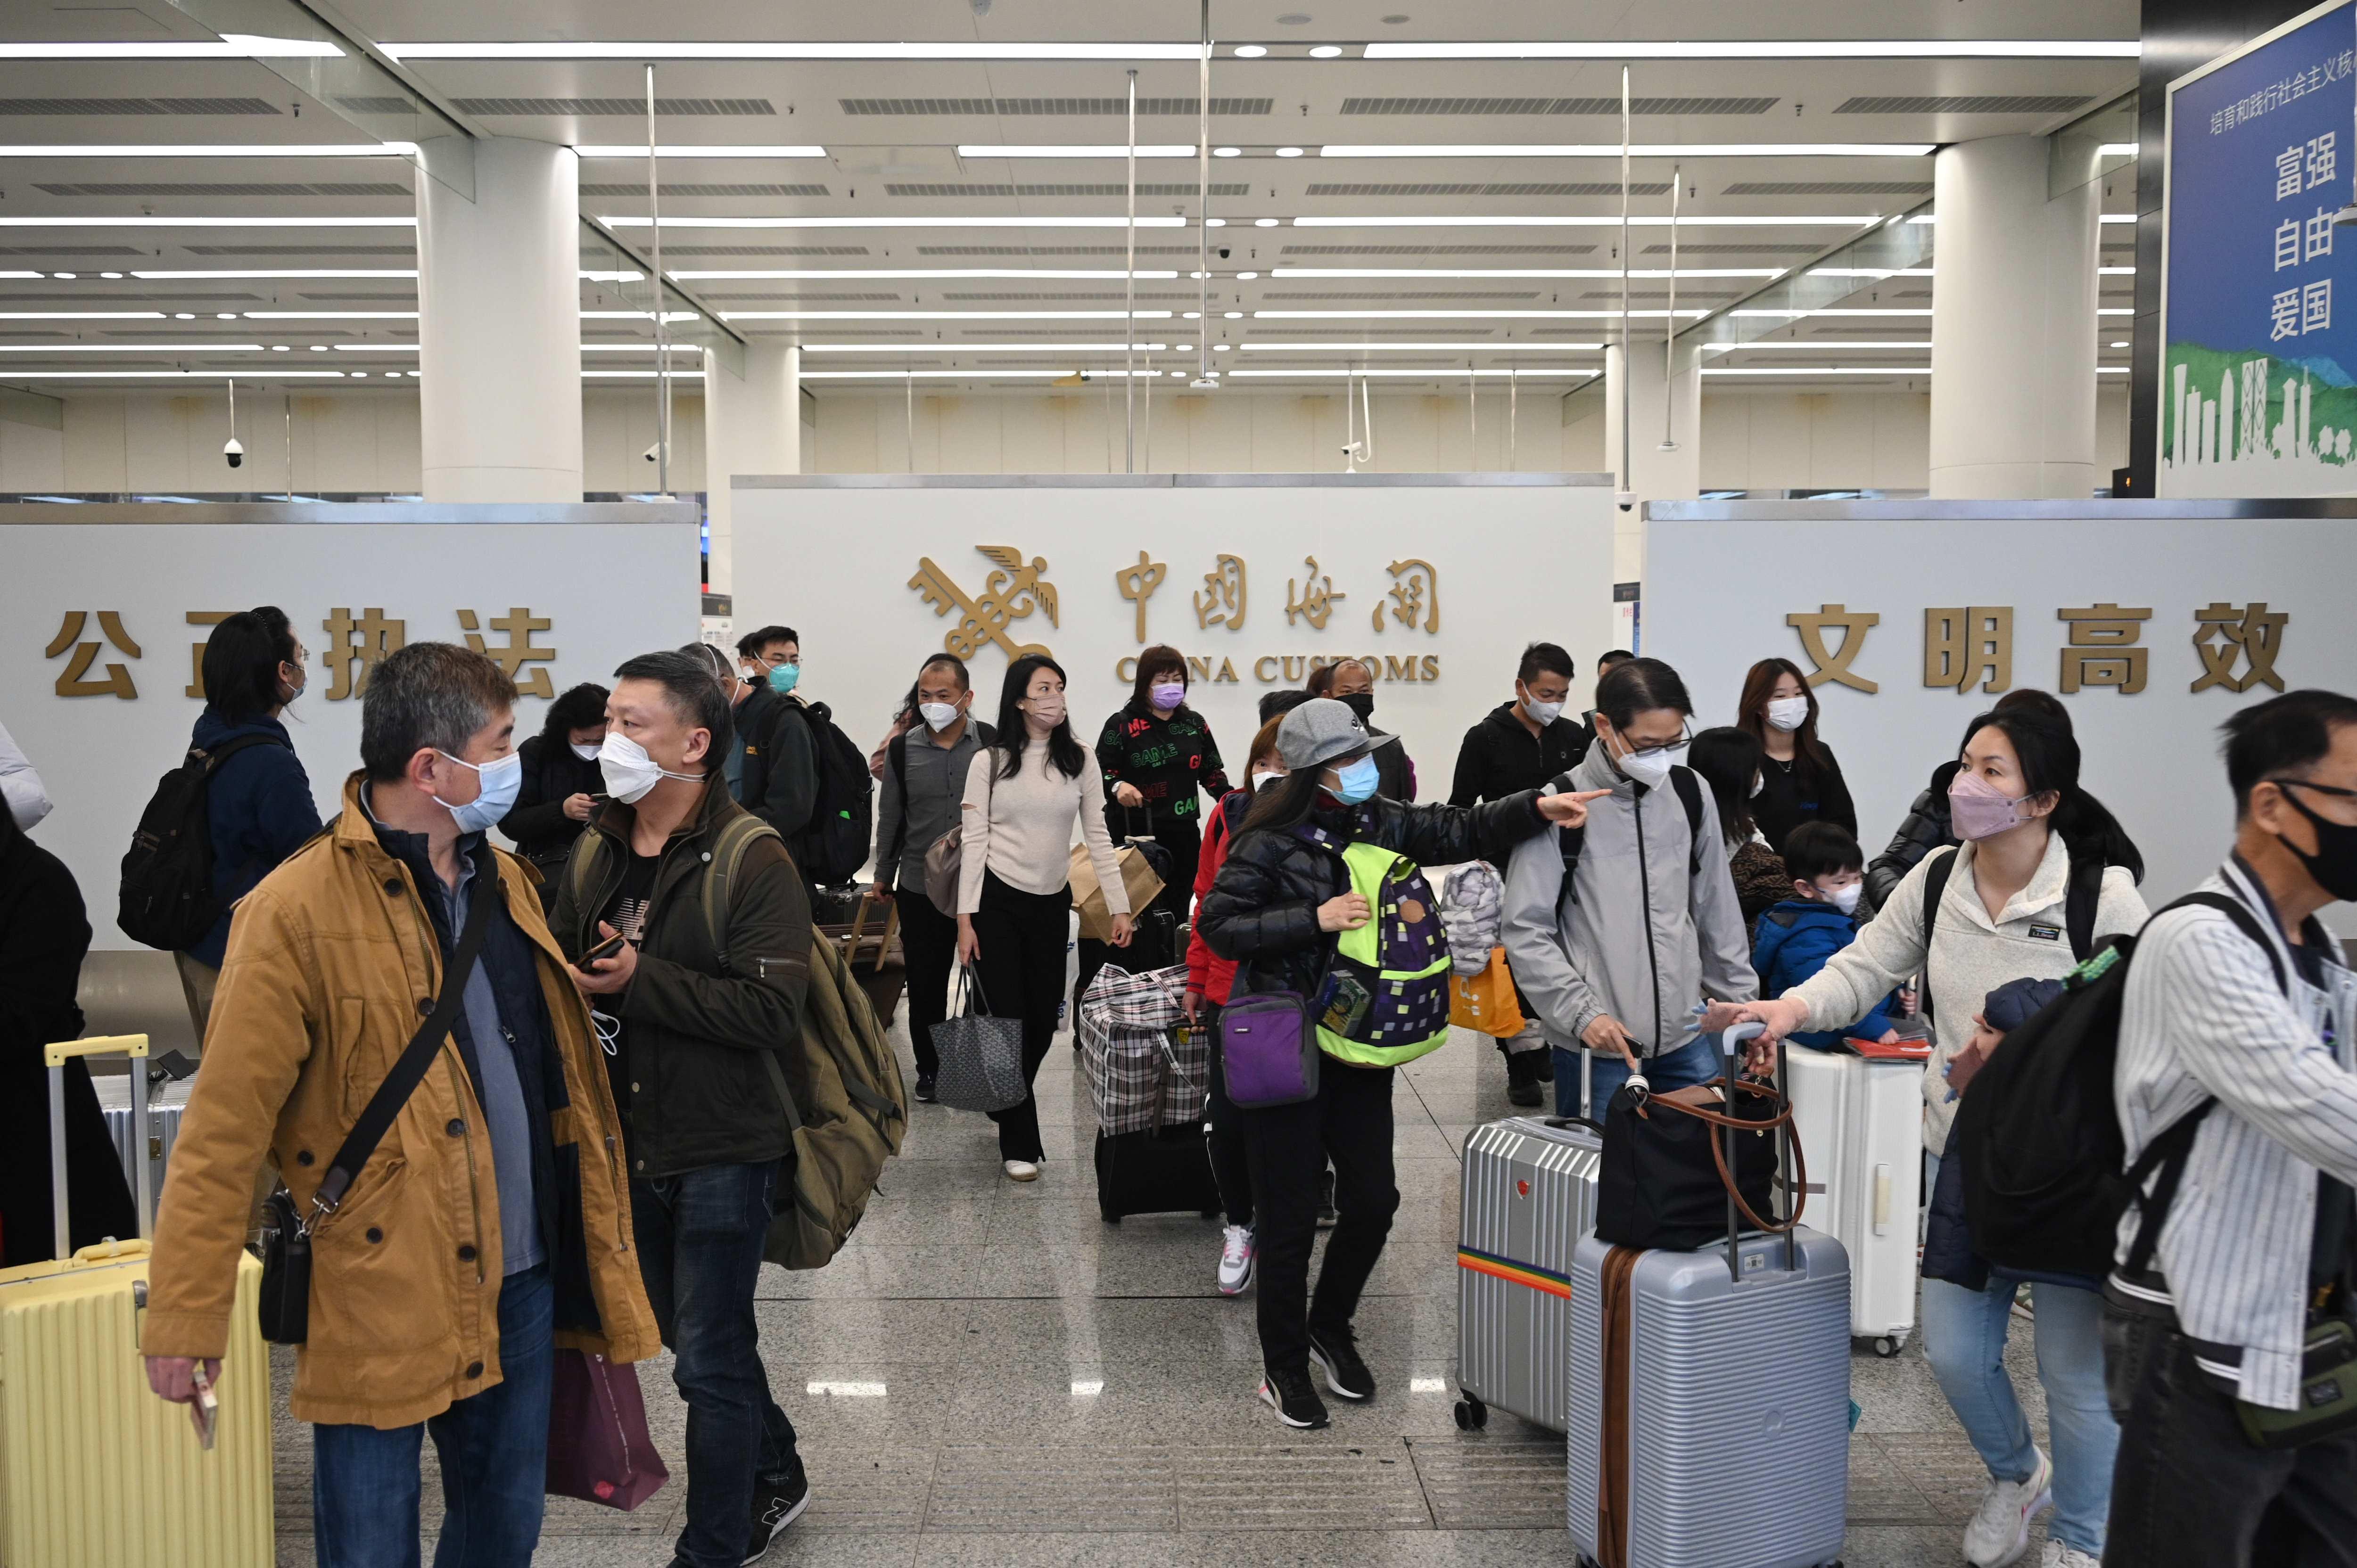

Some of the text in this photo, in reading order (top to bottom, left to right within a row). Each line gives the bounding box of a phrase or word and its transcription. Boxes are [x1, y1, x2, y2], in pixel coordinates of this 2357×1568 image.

[2210, 49, 2355, 135] 培育和践行社会主义核
[2276, 131, 2336, 202] 富强
[2275, 206, 2333, 272] 自由
[2270, 278, 2332, 342] 爱国
[1116, 655, 1440, 683] CNA CUSOMS
[1786, 602, 2289, 695] 文明高效
[1104, 730, 1124, 745] GA
